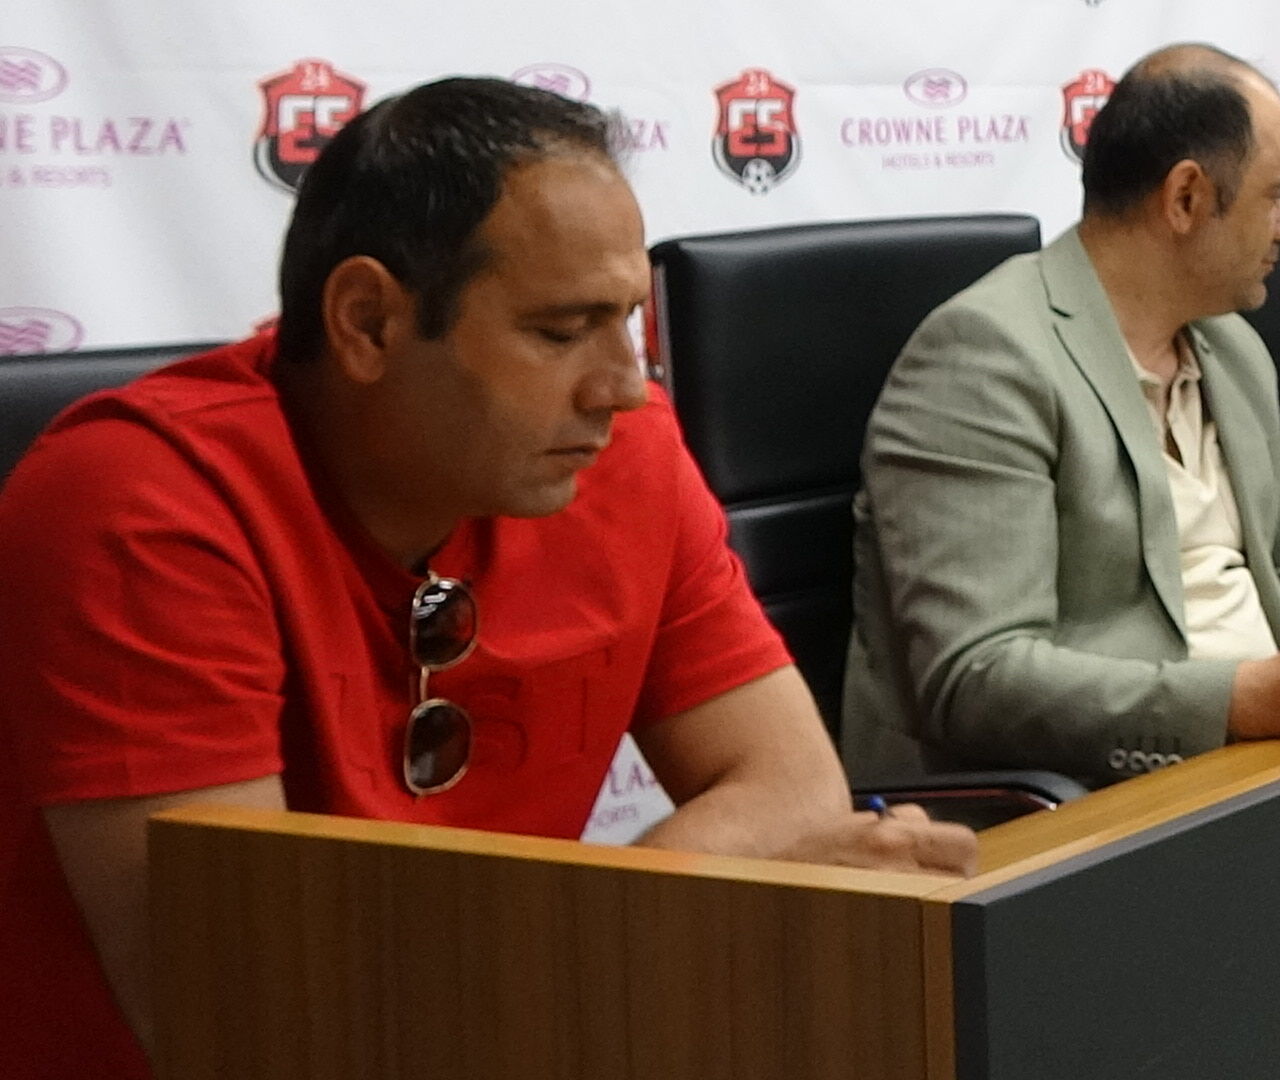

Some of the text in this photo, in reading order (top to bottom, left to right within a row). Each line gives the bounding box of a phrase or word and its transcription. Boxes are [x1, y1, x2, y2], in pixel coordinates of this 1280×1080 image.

[51, 116, 188, 157] PLAZA
[839, 114, 1031, 147] CROWNE PLAZA
